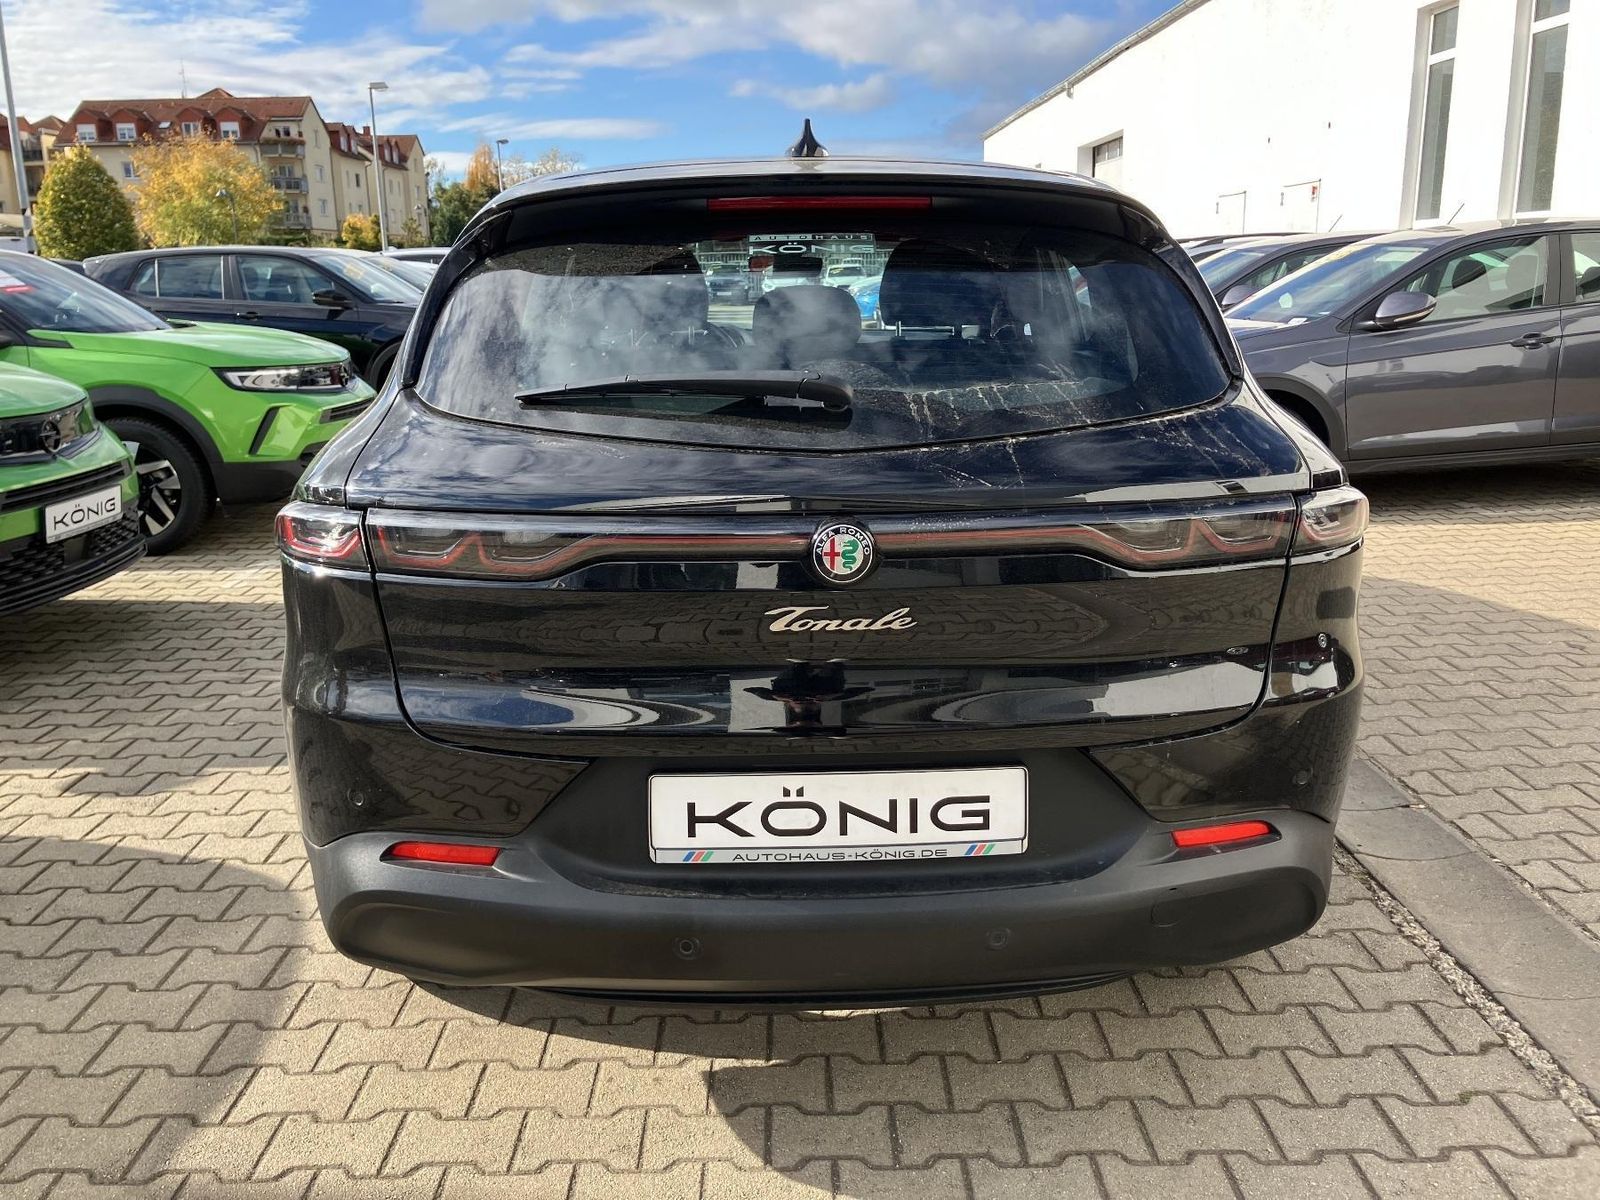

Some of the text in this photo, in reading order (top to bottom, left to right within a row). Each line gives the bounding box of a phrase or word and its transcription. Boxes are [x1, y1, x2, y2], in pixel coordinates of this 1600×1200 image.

[748, 242, 875, 254] KÖNIG
[53, 497, 116, 531] KÖNIG
[816, 527, 870, 555] ALFA ROMEO
[764, 605, 918, 632] Tonale
[687, 785, 991, 838] KÖNIG
[732, 848, 949, 862] AUTOHAUS-KÖNIG.DE
